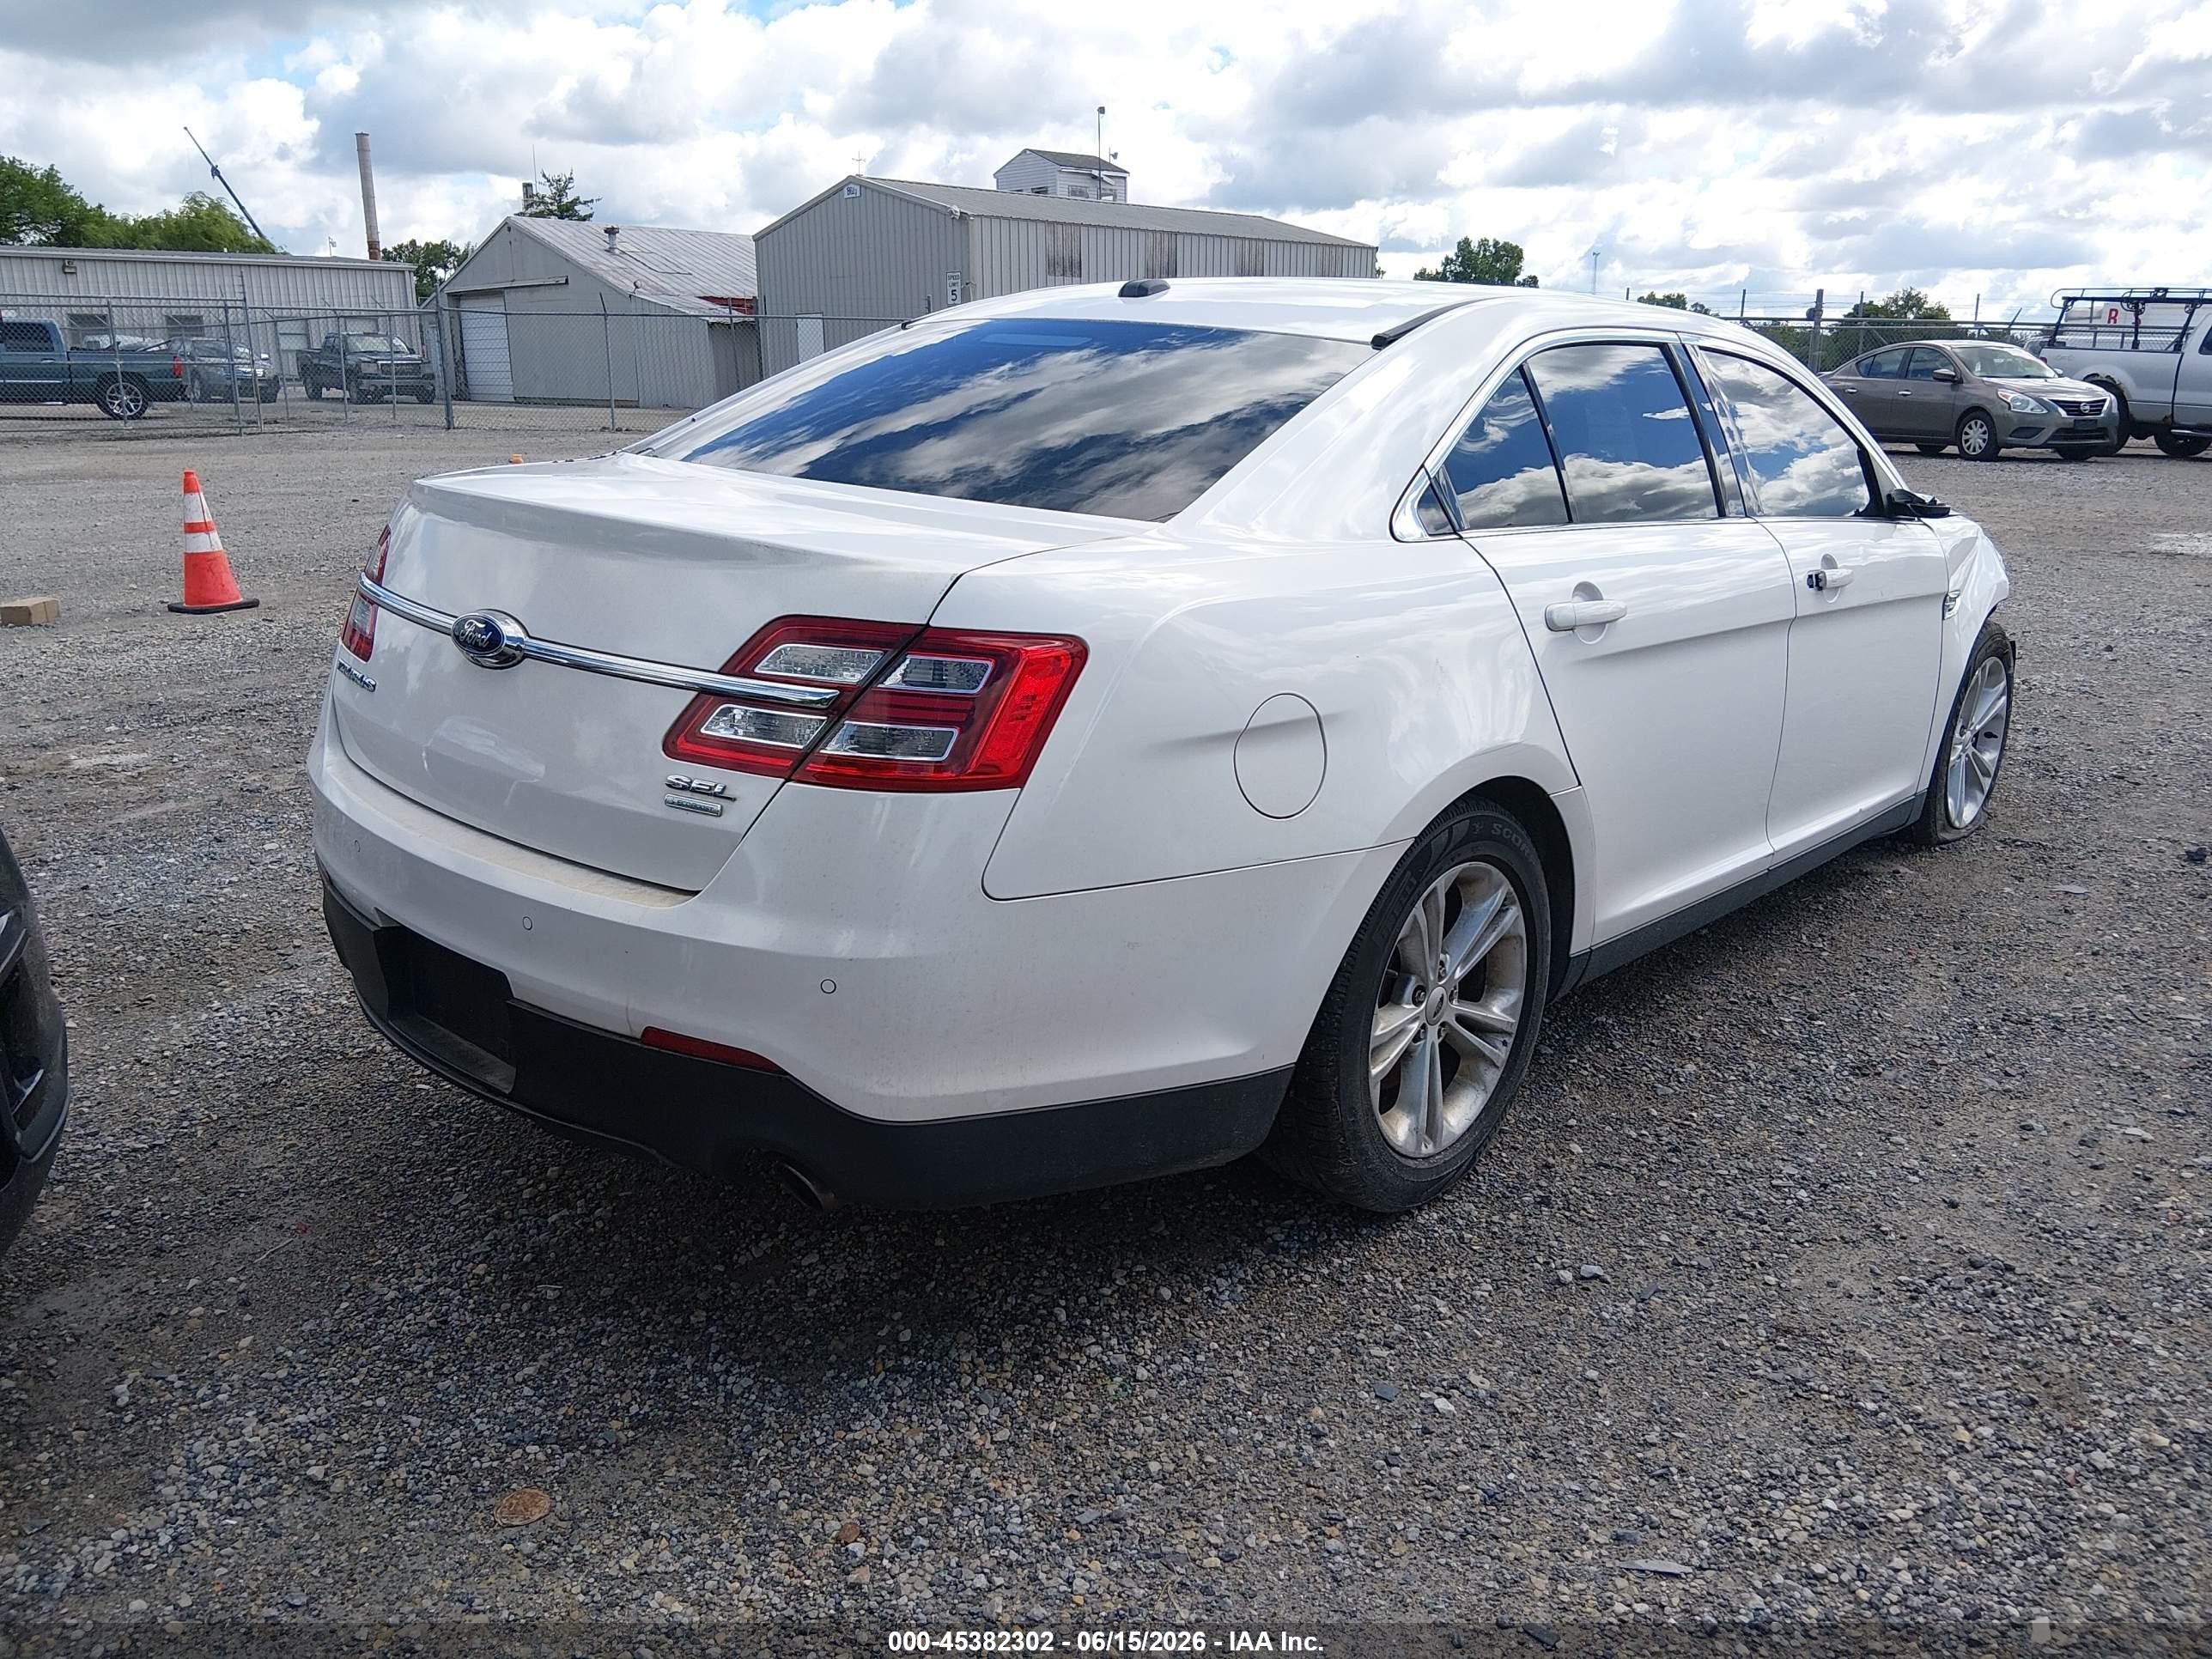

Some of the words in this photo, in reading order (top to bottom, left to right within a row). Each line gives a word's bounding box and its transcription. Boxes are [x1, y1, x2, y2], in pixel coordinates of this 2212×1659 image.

[951, 289, 957, 301] 5
[459, 618, 493, 648] Ford
[665, 774, 737, 803] SEL
